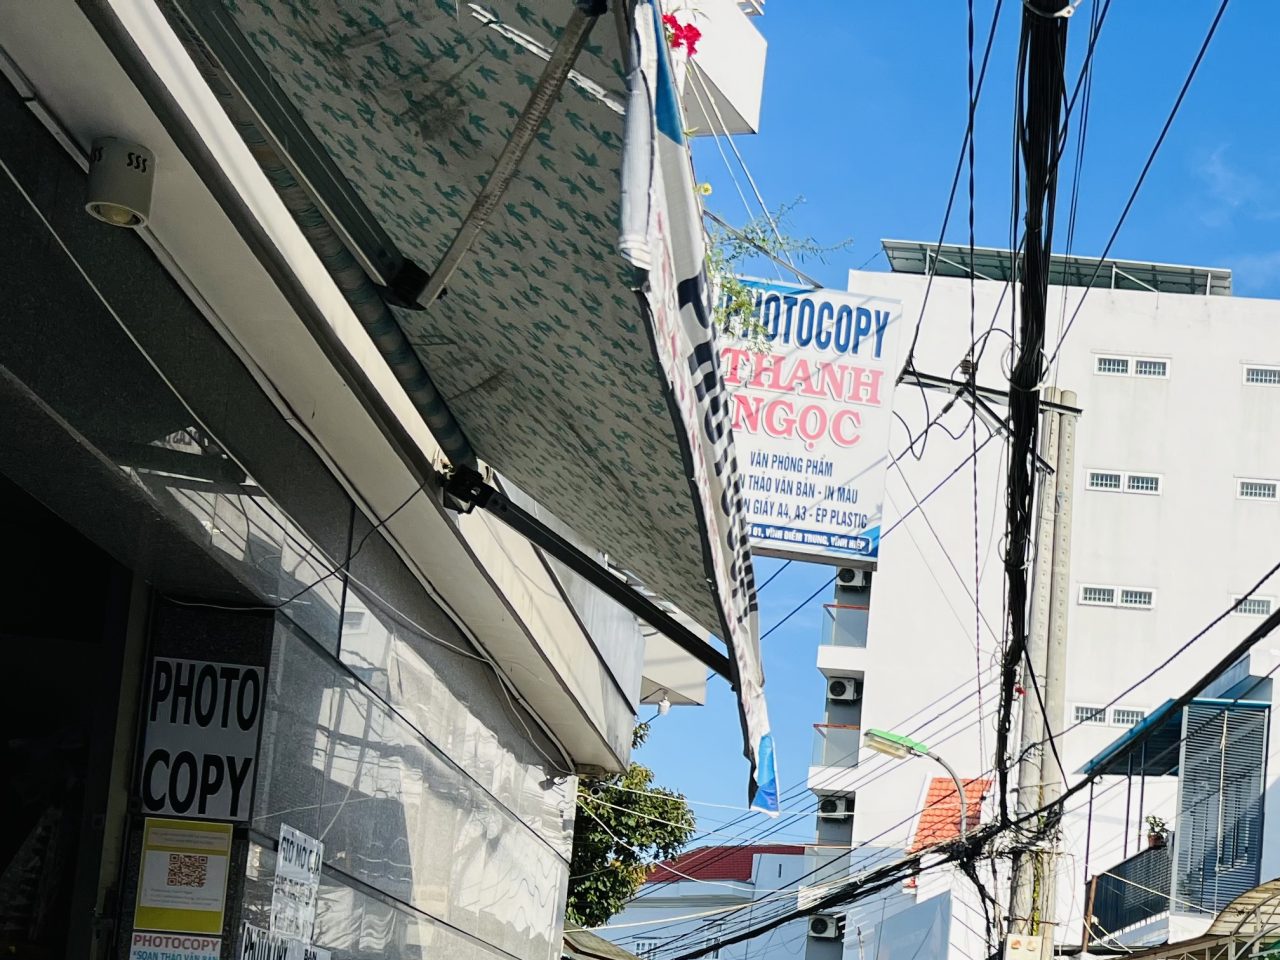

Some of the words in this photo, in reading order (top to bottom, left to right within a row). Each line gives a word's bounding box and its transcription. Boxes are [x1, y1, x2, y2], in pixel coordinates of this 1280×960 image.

[722, 288, 890, 358] OTOCOPY
[720, 347, 884, 405] THANH
[731, 394, 862, 449] NGỌC
[748, 471, 772, 492] THẢO
[775, 476, 793, 496] VĂN
[824, 485, 835, 501] IN
[750, 449, 769, 468] VĂN
[794, 505, 807, 521] A3
[830, 510, 867, 529] PLASTIC
[149, 664, 260, 732] PHOTO
[142, 748, 253, 817] COPY
[133, 934, 220, 952] PHOTOCOPY
